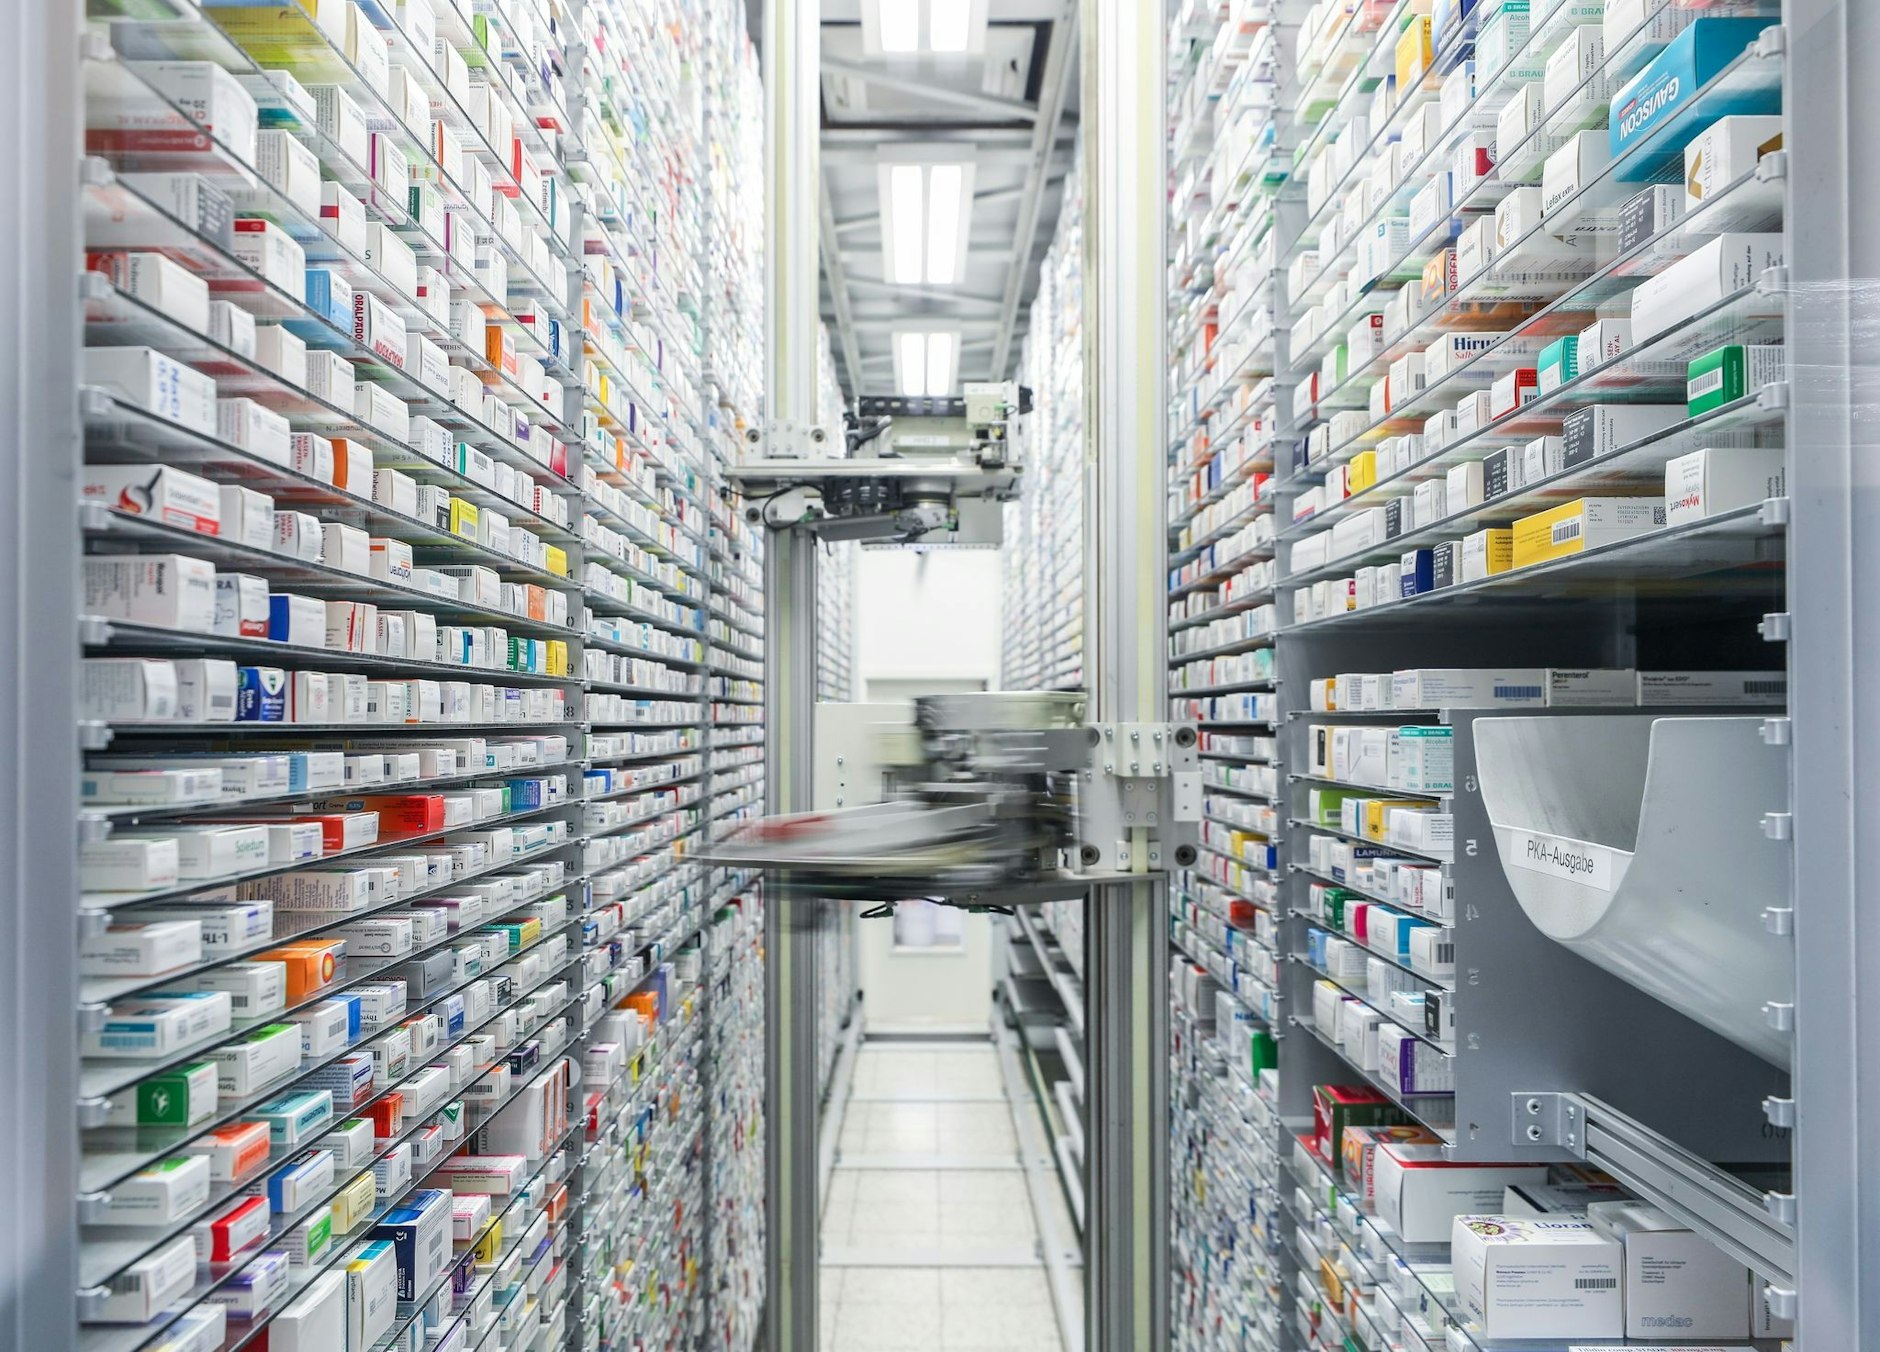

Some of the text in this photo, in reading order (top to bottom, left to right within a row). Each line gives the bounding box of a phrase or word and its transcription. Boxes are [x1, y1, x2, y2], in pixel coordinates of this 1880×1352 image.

[1620, 76, 1680, 142] GAVISCON
[1545, 192, 1562, 210] Lefax
[1562, 183, 1575, 199] extra
[365, 250, 372, 260] S
[1670, 493, 1700, 513] Mykosert
[389, 564, 412, 583] Voltaren
[1552, 671, 1589, 679] Perenterol
[1527, 839, 1594, 874] PKA-Ausgabe
[1365, 1147, 1374, 1199] NUROFEN
[1641, 1314, 1694, 1328] medac
